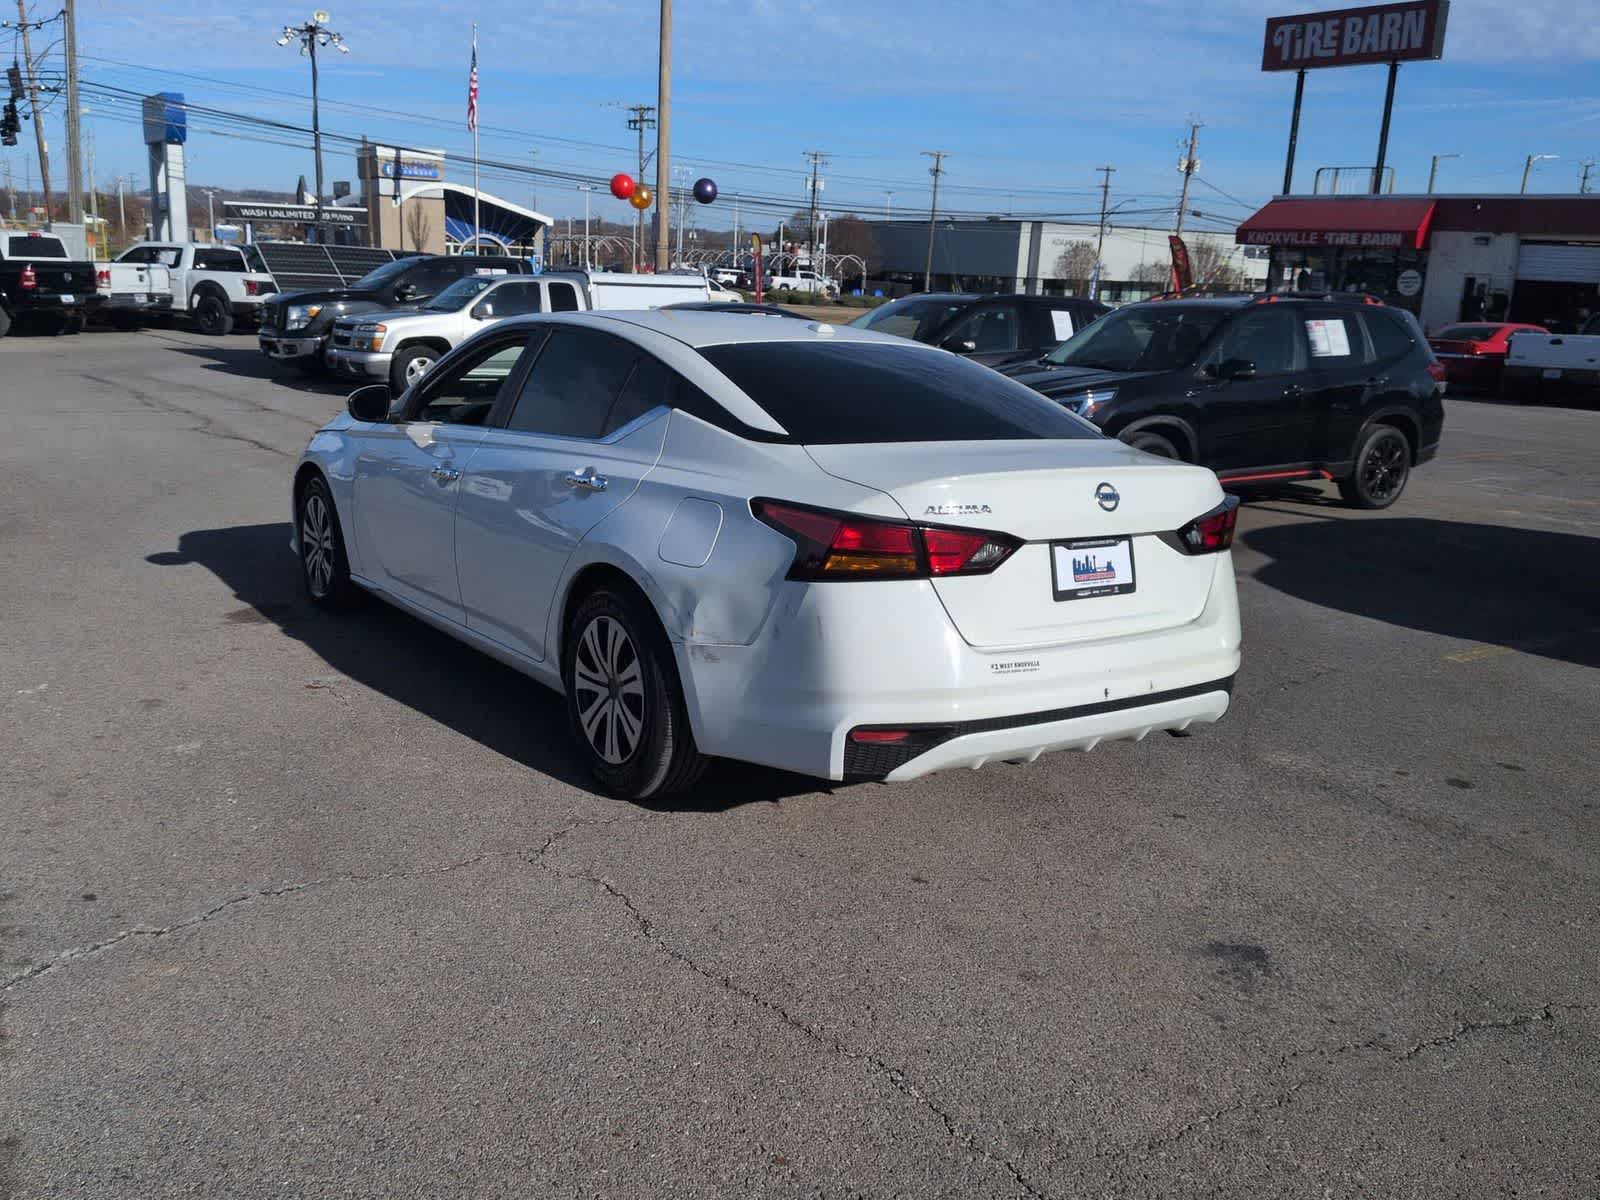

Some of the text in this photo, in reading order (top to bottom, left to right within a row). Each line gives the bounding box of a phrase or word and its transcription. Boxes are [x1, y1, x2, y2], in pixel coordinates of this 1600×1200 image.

[1342, 10, 1427, 55] BARN
[240, 208, 267, 217] WASH
[268, 209, 316, 219] UNLIMITED
[1247, 231, 1318, 245] KNOXVILLE
[1360, 232, 1404, 246] BARN
